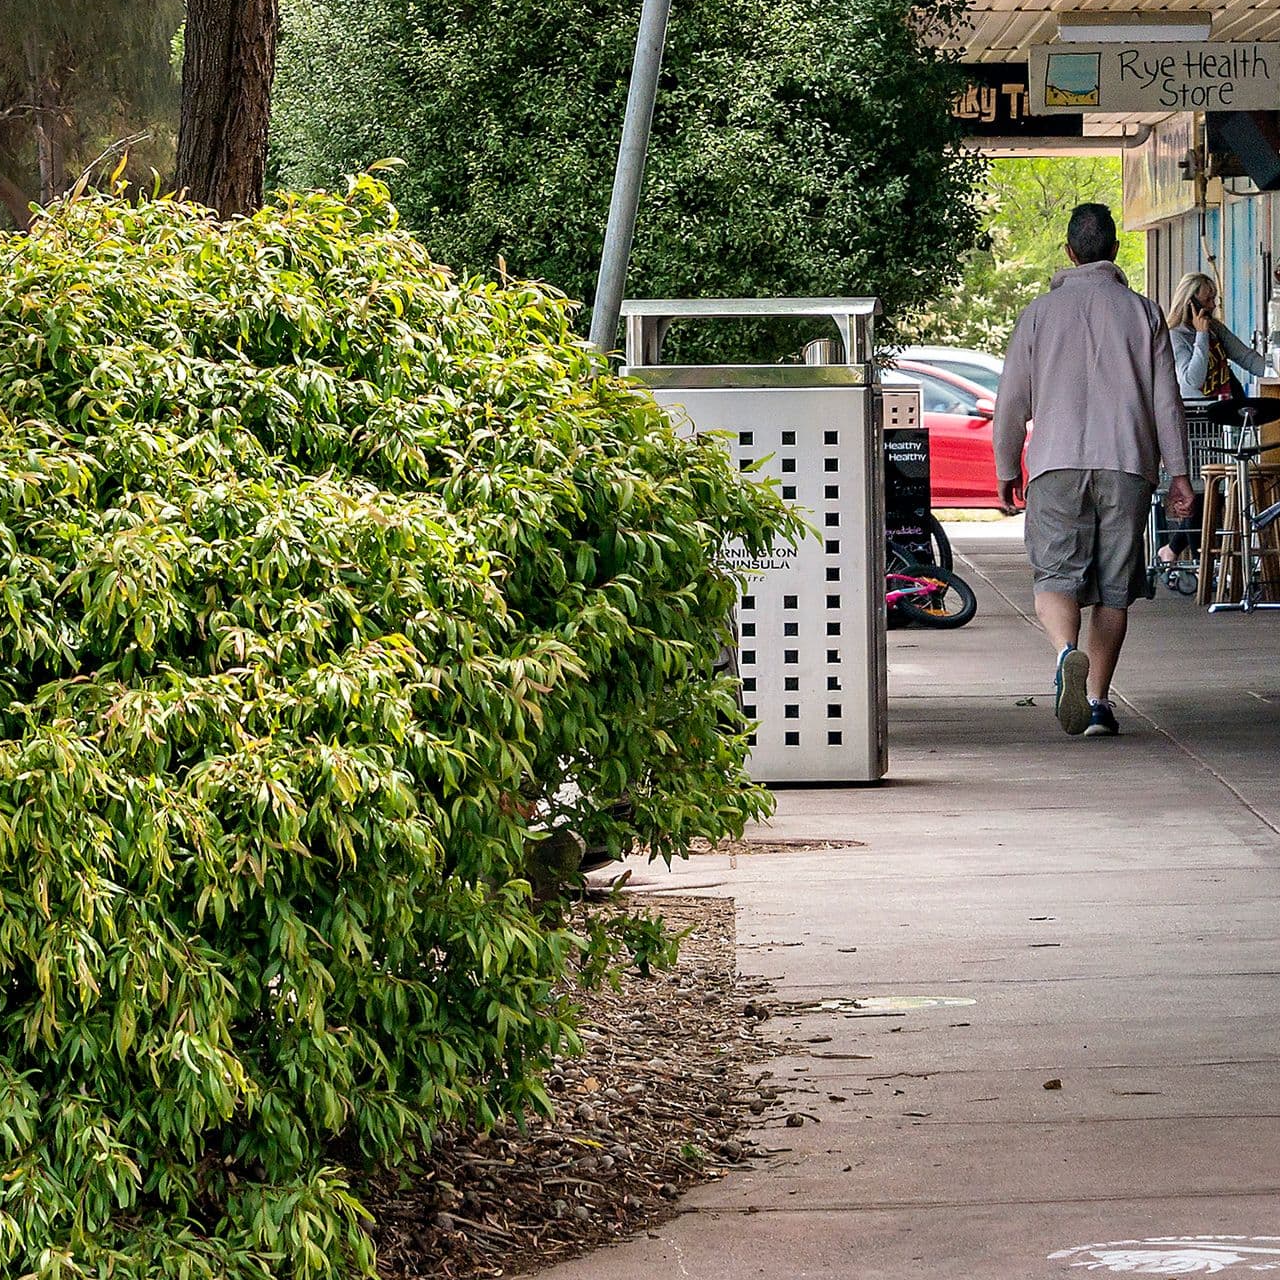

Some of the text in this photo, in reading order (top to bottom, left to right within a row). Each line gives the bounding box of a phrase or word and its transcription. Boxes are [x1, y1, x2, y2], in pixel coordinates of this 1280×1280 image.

[1118, 45, 1270, 89] Rye Health
[1159, 78, 1234, 107] Store
[884, 442, 921, 451] Healthy
[888, 452, 927, 462] Healthy
[713, 559, 790, 569] ENINSULA
